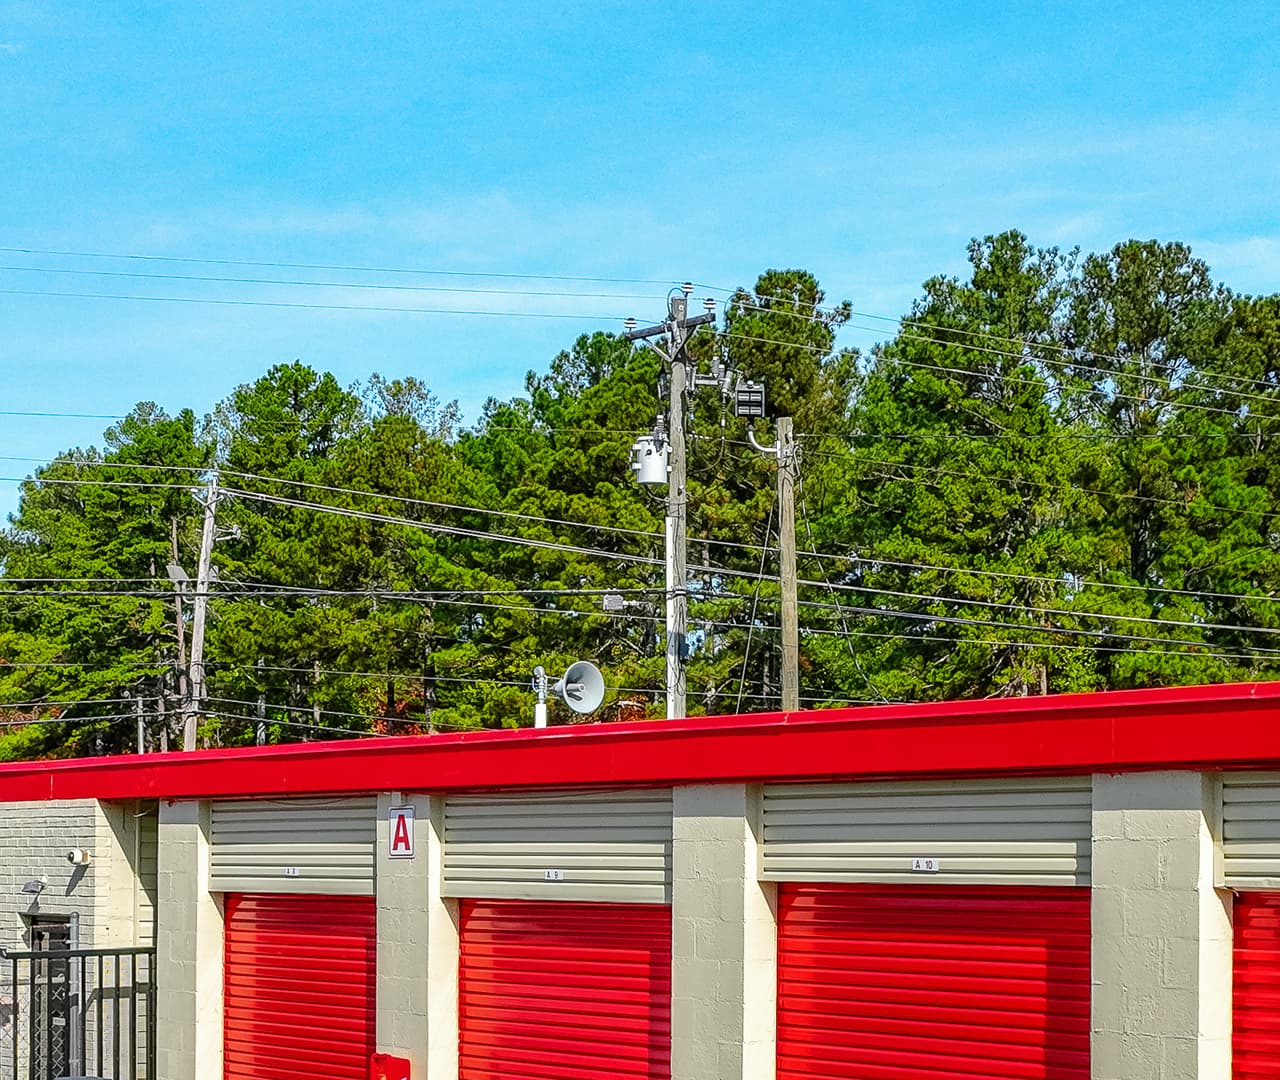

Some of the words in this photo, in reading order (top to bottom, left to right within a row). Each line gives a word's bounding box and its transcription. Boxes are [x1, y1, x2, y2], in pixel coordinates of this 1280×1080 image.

[392, 814, 411, 851] A
[915, 860, 920, 869] A
[925, 860, 933, 870] 10
